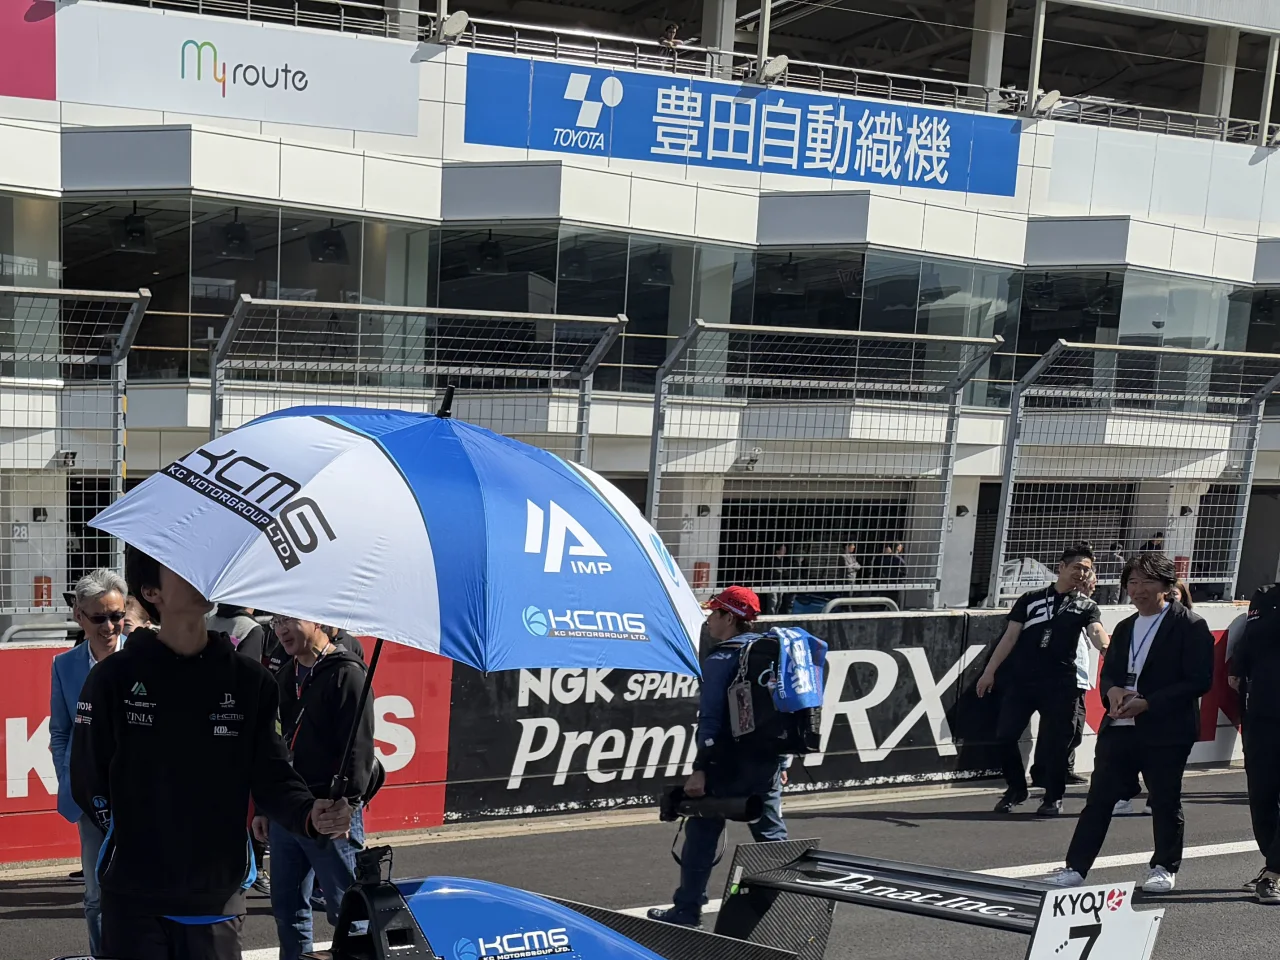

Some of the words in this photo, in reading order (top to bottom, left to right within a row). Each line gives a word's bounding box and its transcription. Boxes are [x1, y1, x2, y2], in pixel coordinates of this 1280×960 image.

[232, 62, 309, 92] route
[552, 127, 605, 151] TOYOTA
[650, 85, 951, 185] 豊田自動織機
[167, 464, 187, 479] KC
[186, 474, 270, 525] MOTORGROUP
[266, 523, 291, 564] LTD.
[178, 448, 337, 554] KCMG
[13, 525, 28, 539] 28
[570, 560, 612, 575] IMP
[547, 609, 646, 634] KCMG
[568, 631, 628, 639] MOTORGROUP
[517, 668, 616, 707] NGK
[804, 644, 986, 768] RX
[933, 896, 1015, 917] Inc.
[478, 927, 569, 956] KCMG
[497, 949, 553, 960] MOTORGROUP
